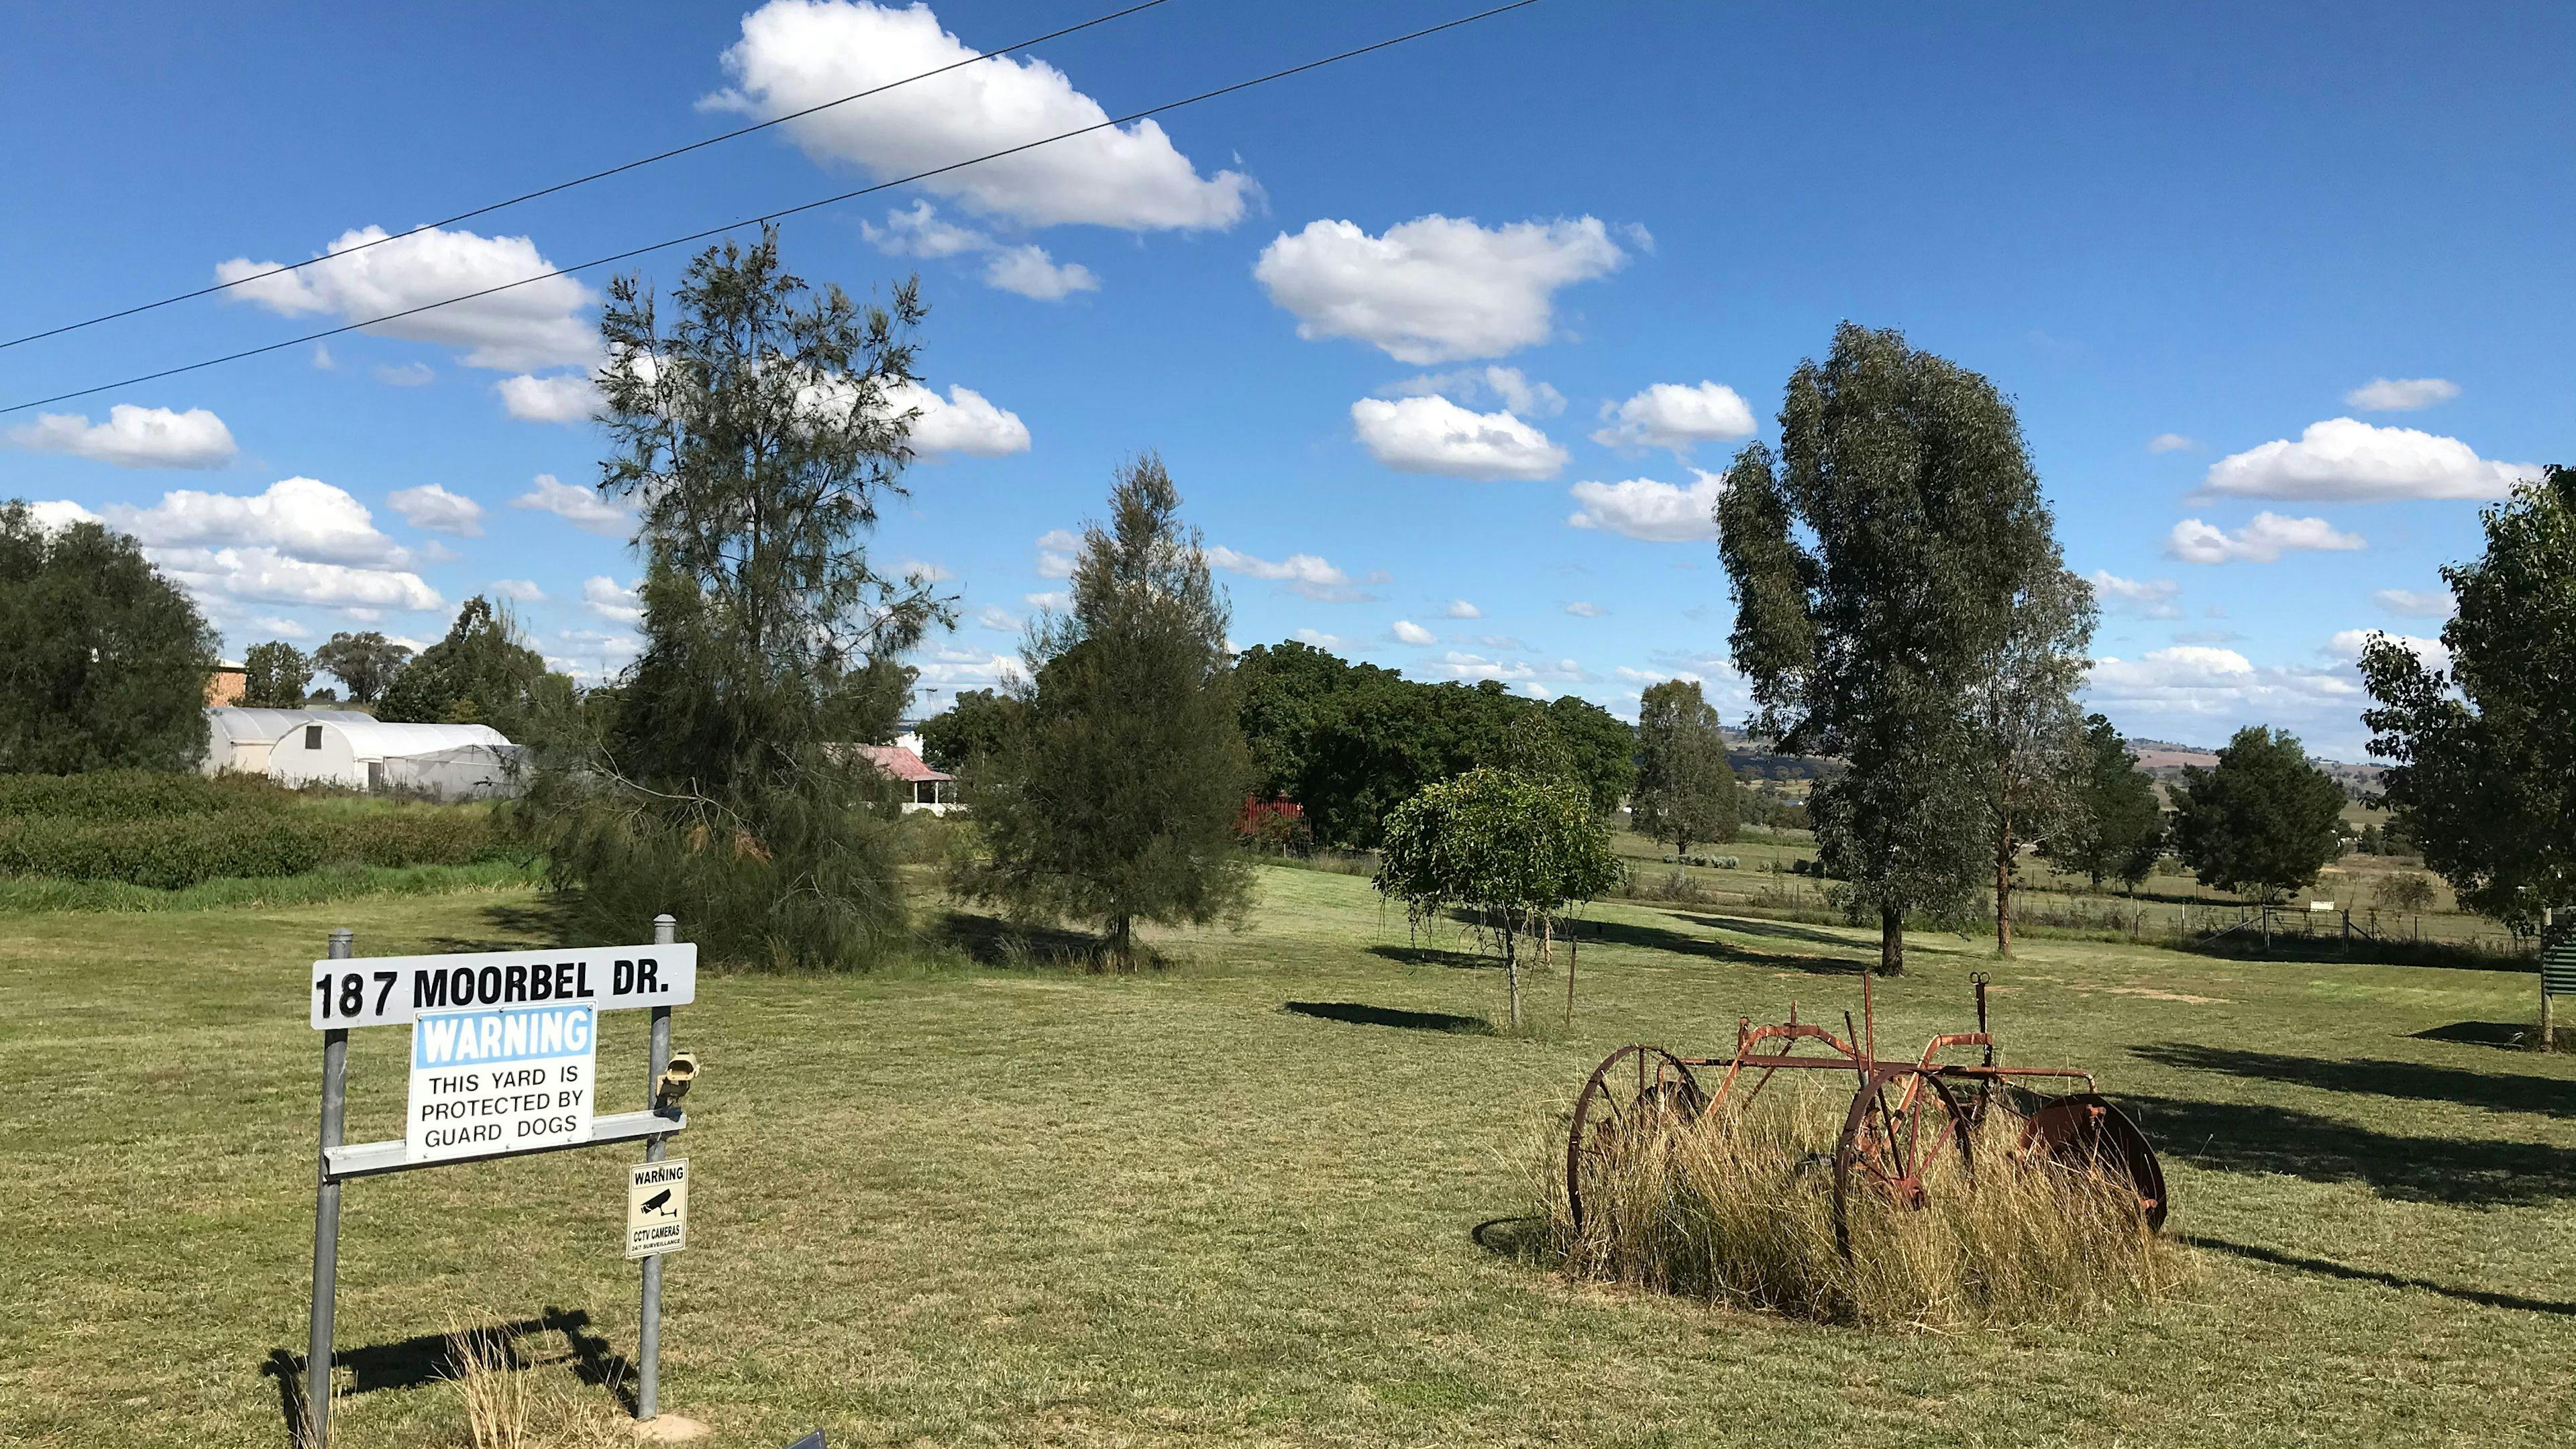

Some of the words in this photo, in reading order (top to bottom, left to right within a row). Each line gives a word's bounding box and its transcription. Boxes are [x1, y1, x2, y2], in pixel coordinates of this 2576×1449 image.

[316, 971, 398, 1019] 187
[413, 962, 594, 1008] MOORBEL
[612, 959, 669, 996] DR.
[424, 1010, 588, 1063] WARNING
[429, 1075, 479, 1095] THIS
[492, 1069, 546, 1089] YARD
[560, 1066, 578, 1083] IS
[422, 1094, 549, 1122] PROTECTED
[558, 1090, 584, 1108] BY
[425, 1124, 501, 1147] GUARD
[518, 1115, 576, 1138] DOGS
[635, 1167, 683, 1185] WARNING
[634, 1230, 650, 1242] CCTV
[651, 1225, 680, 1239] CAMERAS
[643, 1239, 680, 1249] SURVEILLANCE
